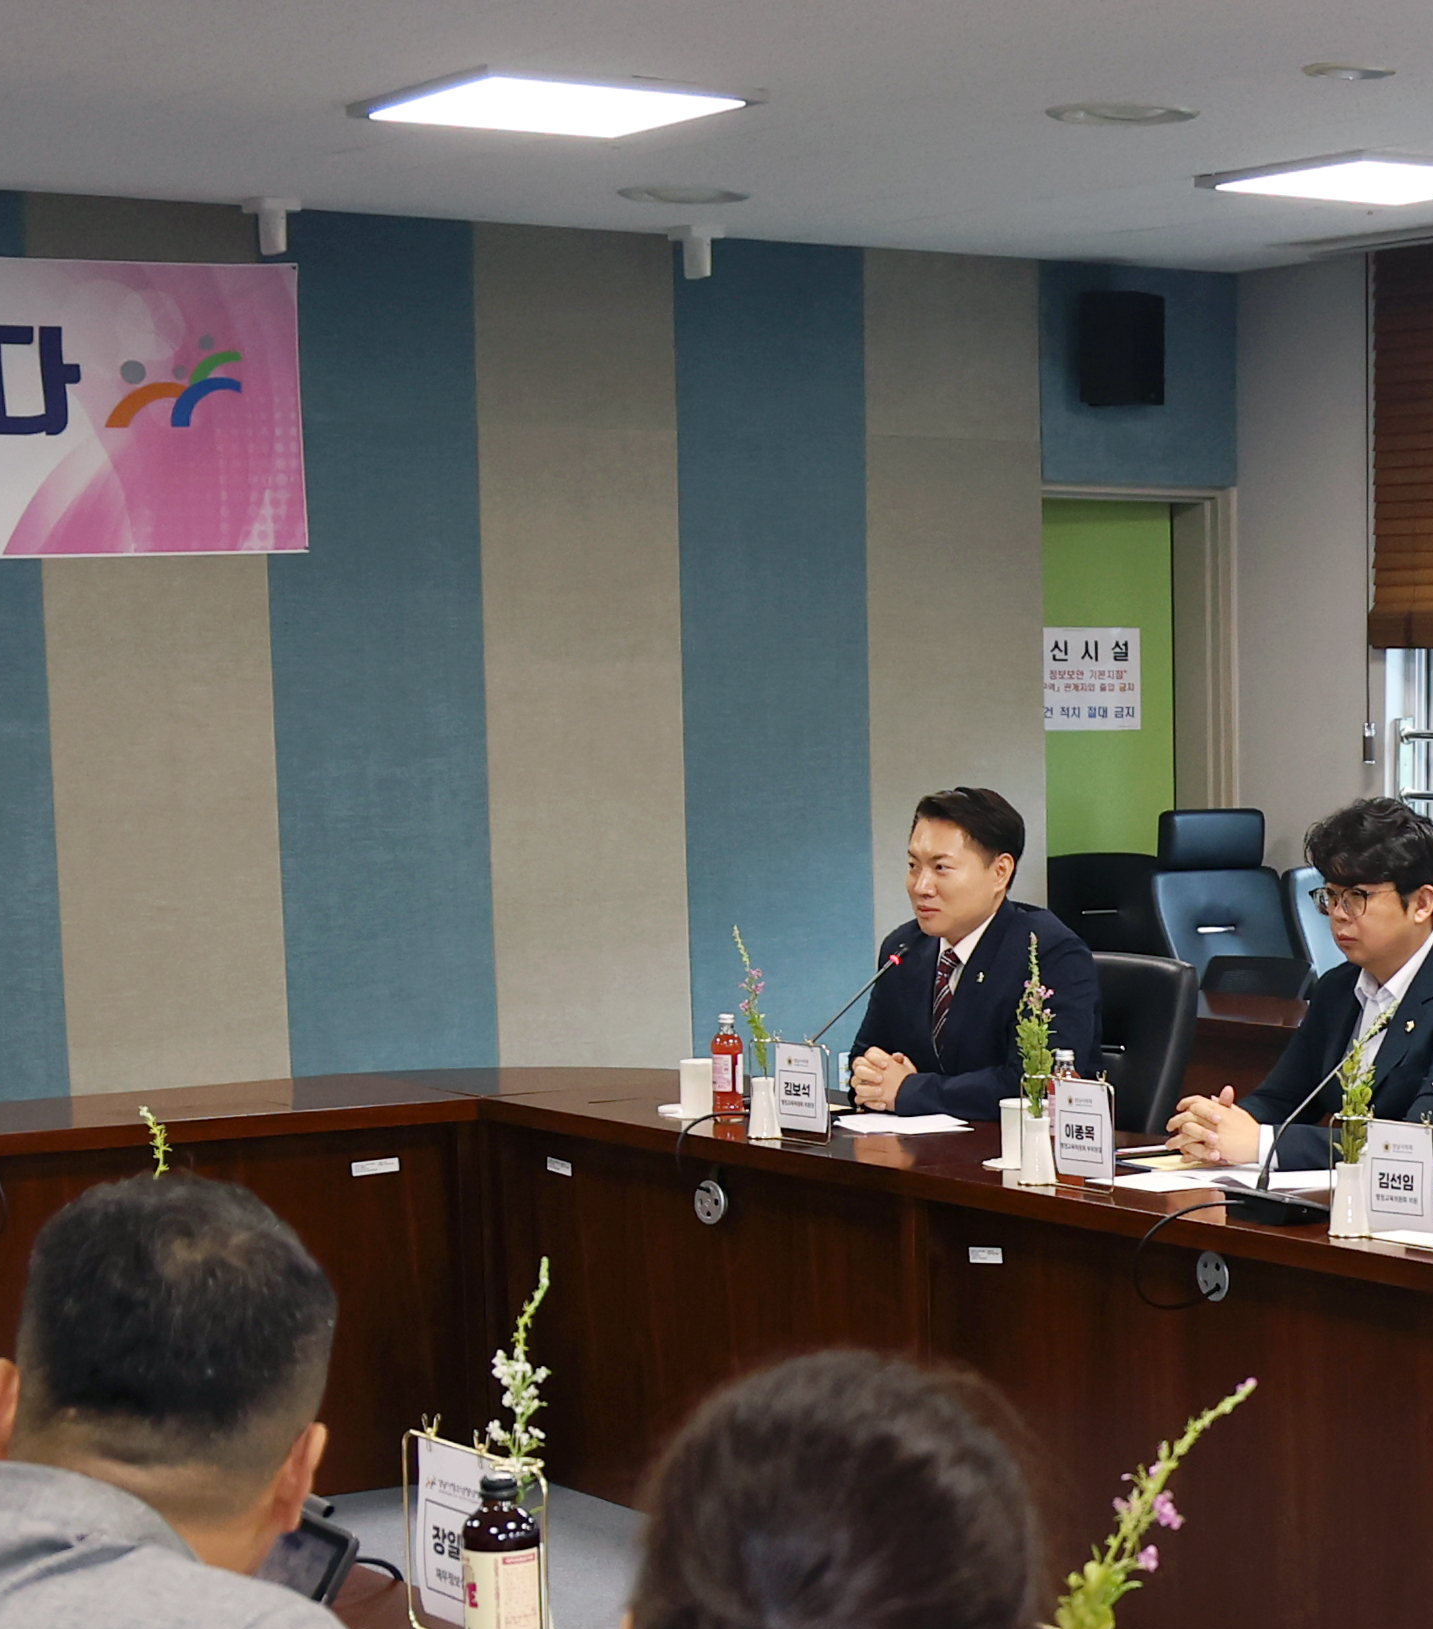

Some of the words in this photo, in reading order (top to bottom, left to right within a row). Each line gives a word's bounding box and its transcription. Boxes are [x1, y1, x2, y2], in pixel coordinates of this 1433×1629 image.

[1060, 706, 1081, 719] 적치
[1087, 706, 1108, 719] 절대
[1114, 706, 1135, 719] 금지
[784, 1081, 811, 1098] 김보석
[1064, 1123, 1095, 1141] 이종목
[1378, 1172, 1414, 1192] 김선임
[432, 1525, 466, 1562] 장일
